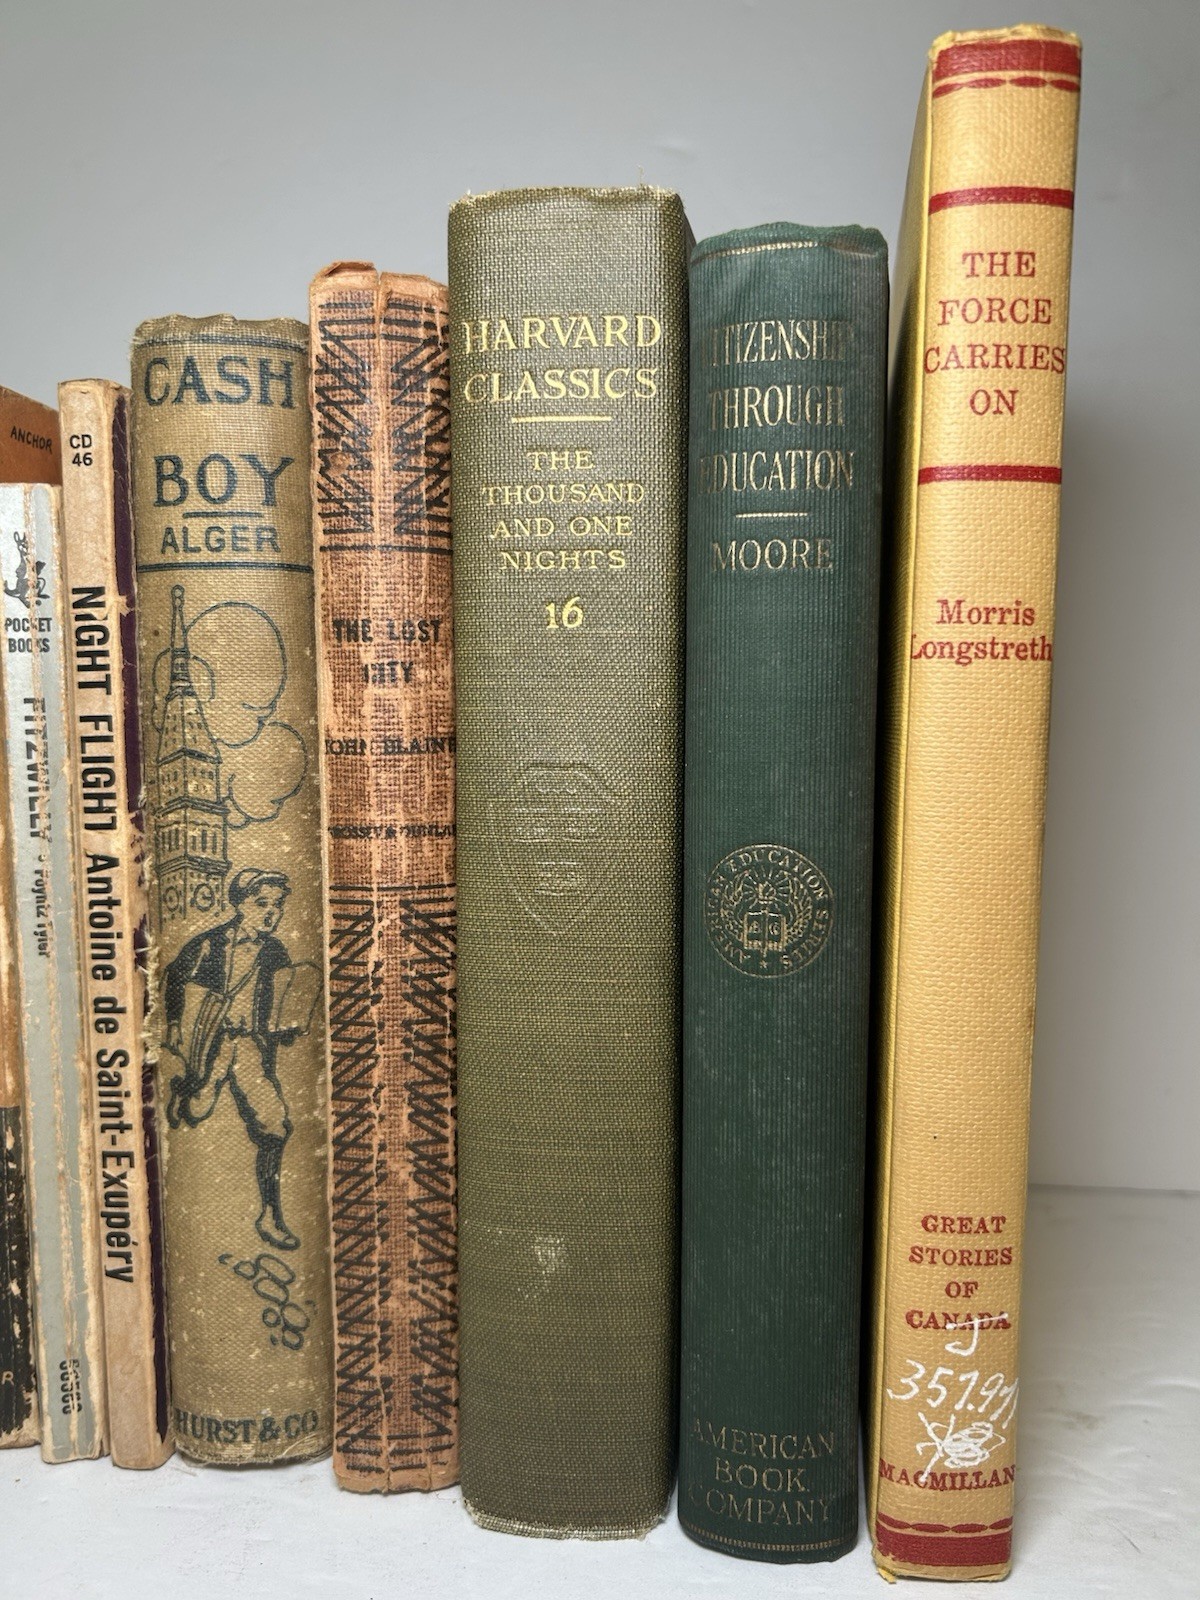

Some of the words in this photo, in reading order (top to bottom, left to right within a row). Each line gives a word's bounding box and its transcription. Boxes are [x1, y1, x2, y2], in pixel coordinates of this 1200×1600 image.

[962, 251, 1036, 278] THE
[937, 297, 1052, 326] FORCE
[464, 315, 662, 354] HARVARD
[924, 343, 1066, 375] CARRIES
[144, 355, 296, 409] CASH
[464, 367, 658, 403] CLASSICS
[709, 384, 847, 431] THROUGH
[969, 389, 1019, 416] ON
[10, 426, 52, 454] ANCHOR
[69, 434, 92, 449] CD
[72, 453, 93, 467] 46
[526, 449, 595, 471] THE
[153, 453, 295, 507] BOY
[482, 482, 645, 507] THOUSAND
[161, 526, 281, 553] ALGER
[490, 516, 555, 539] AND
[569, 515, 633, 537] ONE
[499, 550, 626, 571] NIGHTS
[712, 538, 834, 572] MOORE
[545, 596, 584, 629] 16
[936, 598, 1035, 626] Morris
[72, 586, 112, 695] NIGHT
[332, 618, 373, 643] THE
[387, 617, 442, 642] LOST
[911, 634, 1053, 666] Longstreth
[79, 714, 118, 831] FLIGHT
[726, 850, 829, 901] EDUCATION
[86, 852, 123, 981] Antoine
[93, 996, 127, 1034] de
[96, 1048, 139, 1283] Saint-Exupéry
[921, 1214, 1007, 1234] GREAT
[909, 1246, 1013, 1266] STORIES
[945, 1281, 979, 1298] OF
[905, 1309, 1012, 1330] CANADA
[174, 1407, 256, 1443] HURST
[258, 1416, 281, 1442] &
[284, 1409, 318, 1439] CO
[694, 1418, 835, 1460] AMERICAN
[714, 1456, 808, 1493] BOOK
[879, 1457, 1016, 1492] MACMILLAN
